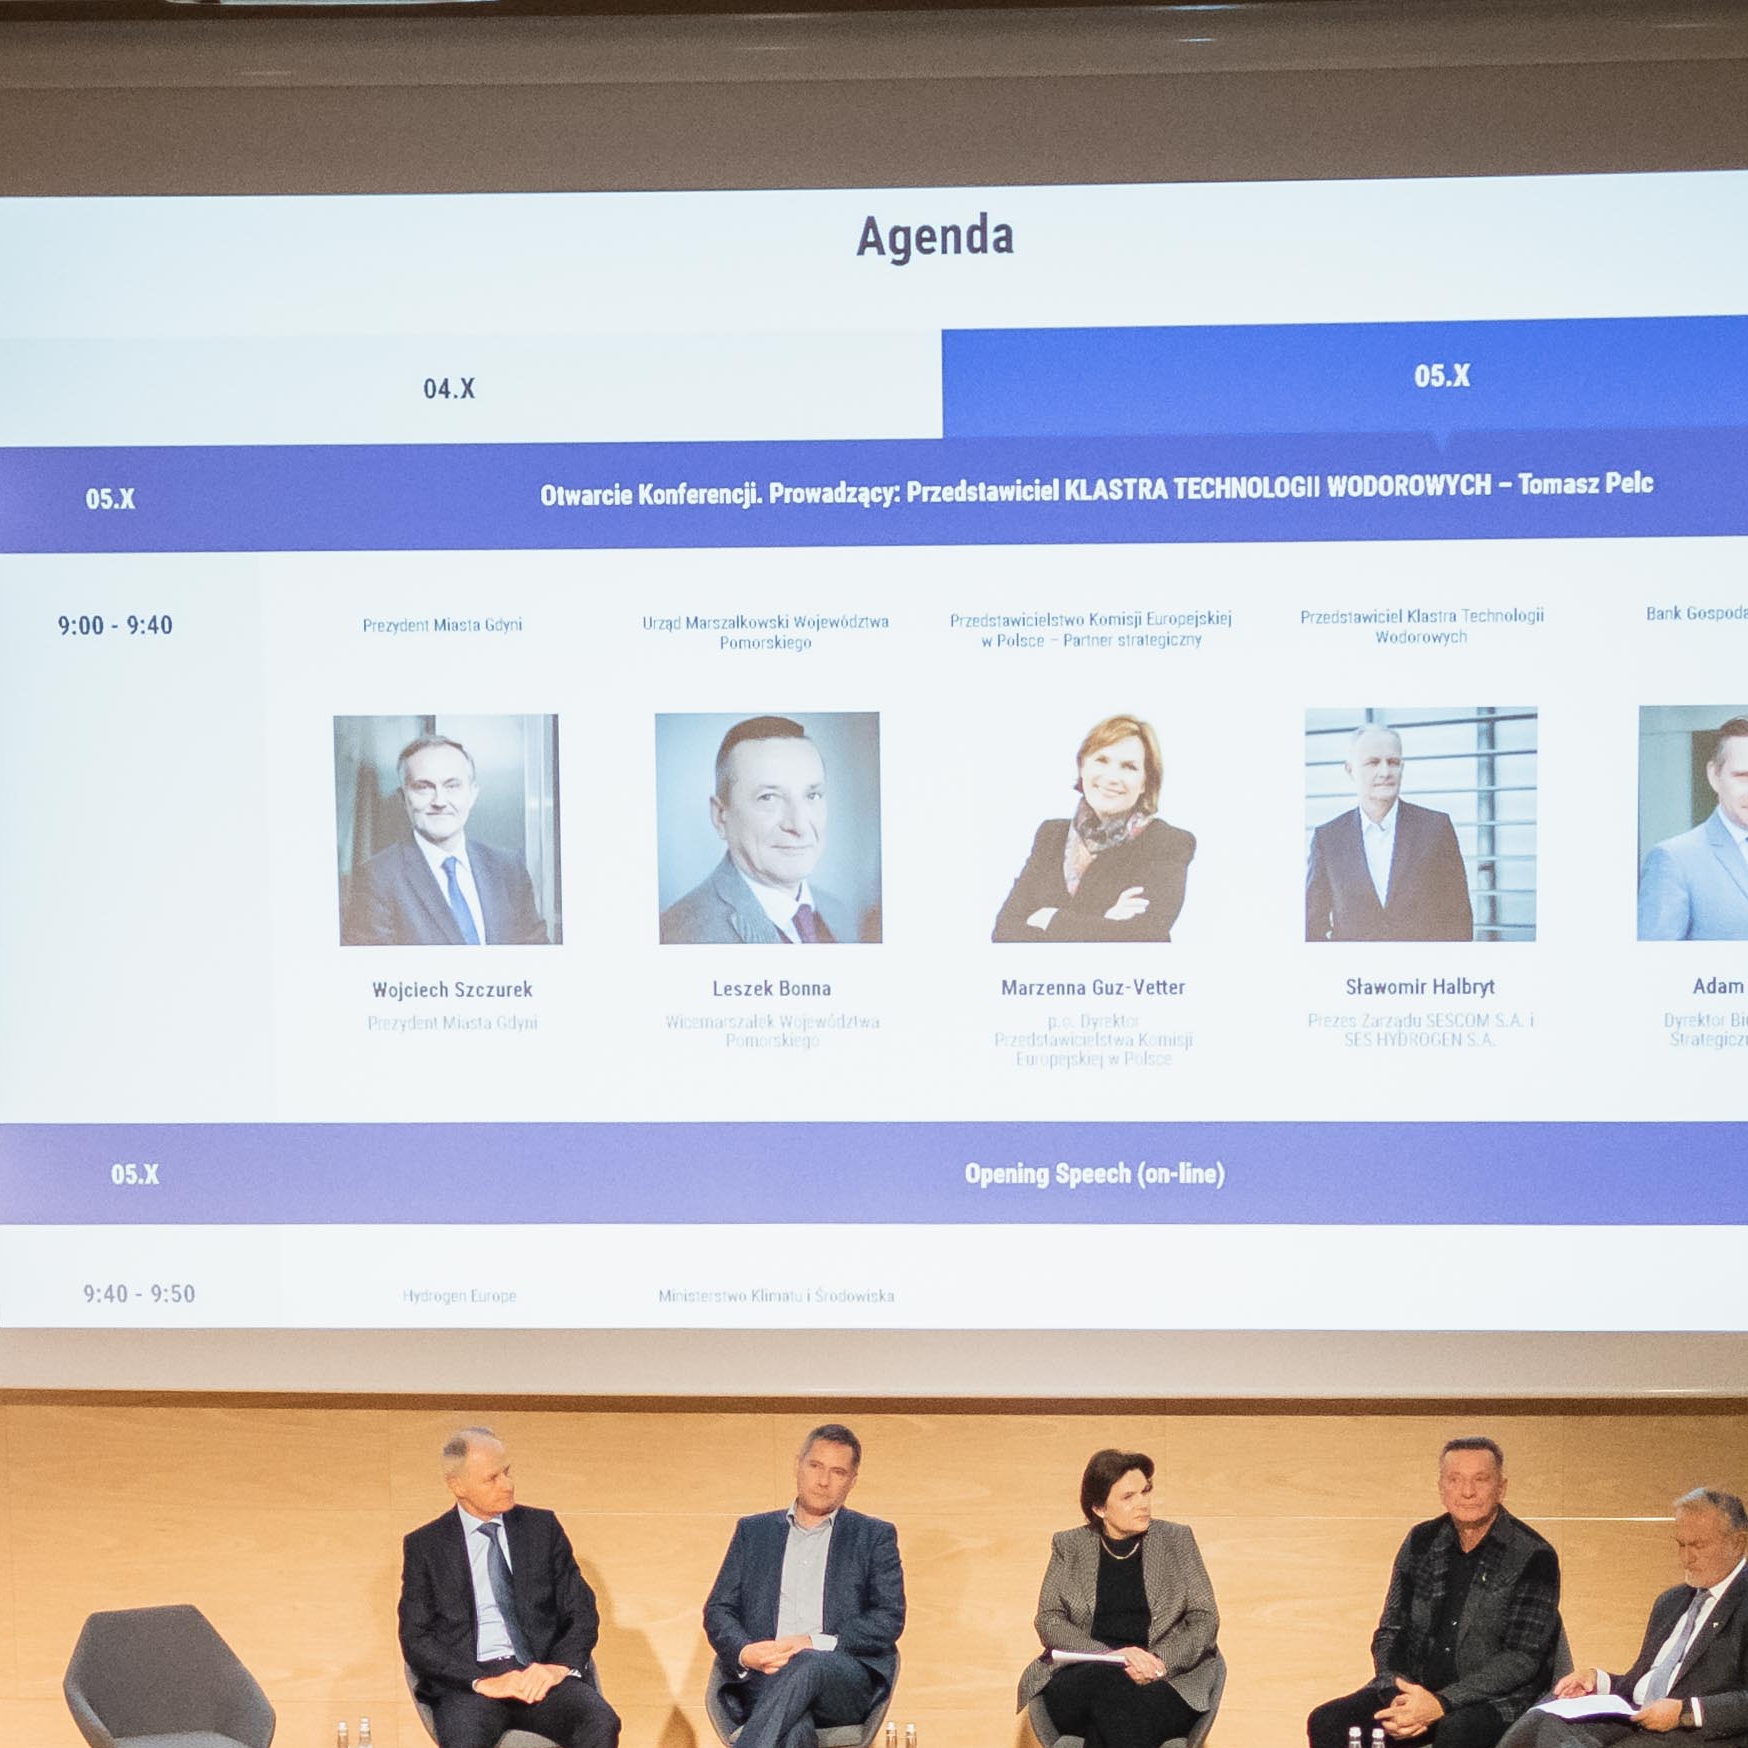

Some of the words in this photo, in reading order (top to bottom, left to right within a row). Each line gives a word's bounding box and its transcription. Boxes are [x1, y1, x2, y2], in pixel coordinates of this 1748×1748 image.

[857, 213, 1014, 266] Agenda
[1415, 363, 1471, 387] 05.X
[424, 378, 475, 399] 04.X
[86, 488, 135, 509] 05.X
[541, 484, 633, 506] Otwarcie
[638, 482, 762, 509] Konferencji.
[770, 481, 900, 508] Prowadzący:
[907, 479, 1059, 503] Przedstawiciel
[1065, 478, 1167, 500] KLASTRA
[1174, 475, 1320, 501] TECHNOLOGII
[1328, 473, 1492, 499] WODOROWYCH
[1518, 471, 1599, 496] Tomasz
[1606, 470, 1654, 495] Pelc
[951, 612, 1085, 628] Przedstawicielstwo
[1089, 611, 1142, 629] Komisji
[1147, 610, 1232, 629] Europejskiej
[1301, 609, 1403, 625] Przedstawiciel
[1407, 608, 1457, 623] Klastra
[1462, 607, 1544, 626] Technologii
[1646, 605, 1682, 621] Bank
[59, 616, 104, 636] 9:00
[127, 615, 172, 635] 9:40
[363, 618, 430, 635] Prezydent
[435, 617, 480, 632] Miasta
[485, 617, 522, 634] Gdyni
[643, 616, 681, 633] Urząd
[794, 614, 889, 632] Województwa
[721, 635, 812, 652] Pomorskiego
[997, 634, 1044, 647] Polsce
[1063, 633, 1112, 647] Partner
[1118, 632, 1202, 650] strategiczny
[1376, 629, 1468, 646] Wodorowych
[373, 981, 448, 1002] Wojciech
[455, 981, 533, 998] Szczurek
[713, 980, 773, 996] Leszek
[780, 981, 831, 996] Bonna
[1002, 980, 1086, 995] Marzenna
[1093, 979, 1186, 995] Guz-Vetter
[1346, 977, 1426, 996] Sławomir
[1433, 977, 1495, 999] Halbryt
[1693, 977, 1744, 995] Adam
[112, 1164, 159, 1184] 05.X
[965, 1161, 1051, 1189] Opening
[1057, 1160, 1131, 1187] Speech
[1137, 1160, 1225, 1189] (on-line)
[84, 1285, 127, 1303] 9:40
[151, 1285, 195, 1303] 9:50
